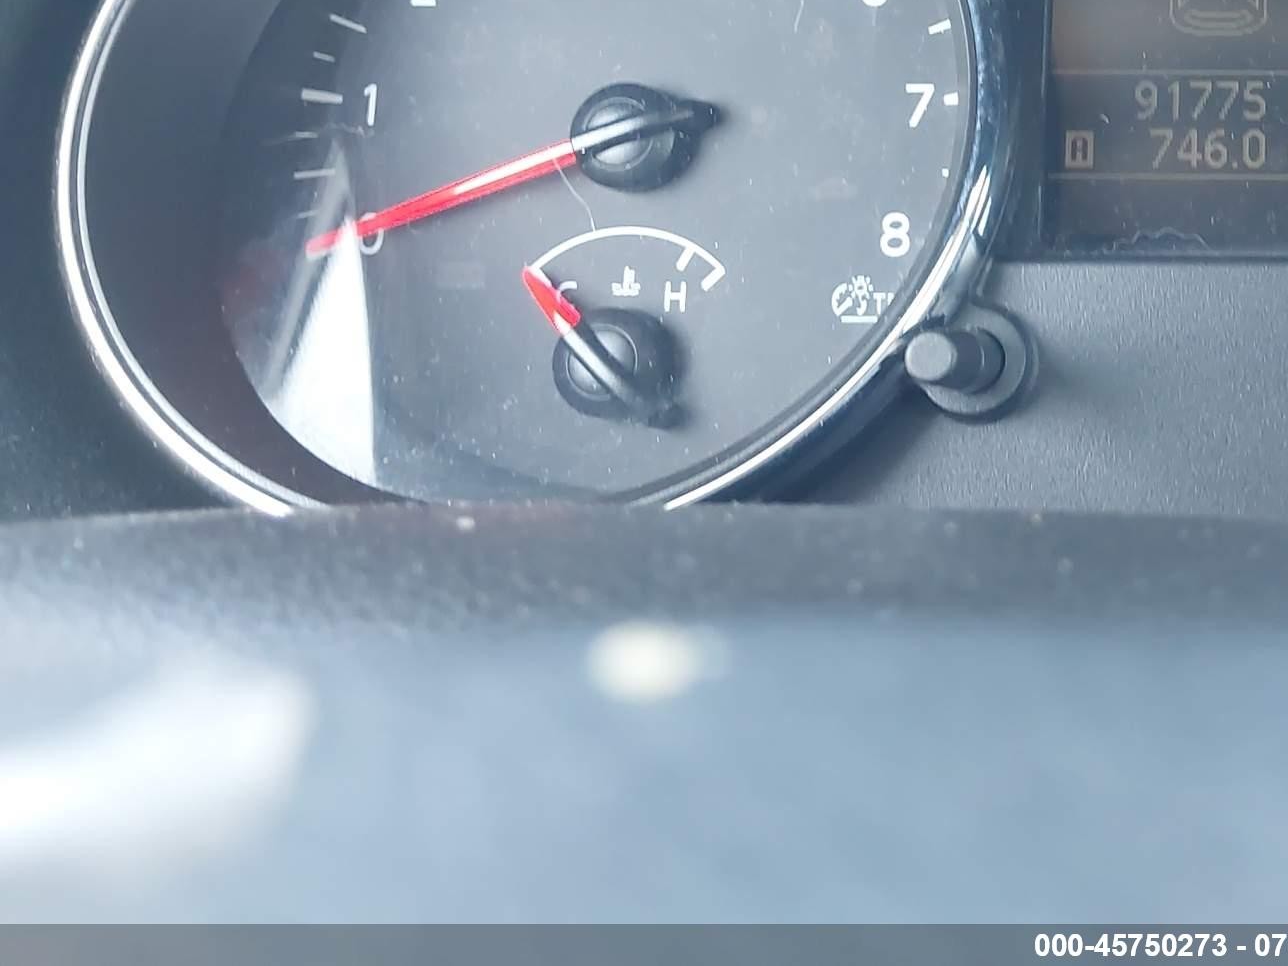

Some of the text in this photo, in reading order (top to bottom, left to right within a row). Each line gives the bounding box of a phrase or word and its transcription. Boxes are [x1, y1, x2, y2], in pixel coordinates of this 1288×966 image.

[364, 83, 378, 126] 1
[905, 83, 935, 128] 7
[1135, 80, 1266, 121] 91775
[1151, 129, 1266, 169] 746.0
[879, 212, 911, 257] 8
[663, 280, 687, 313] H
